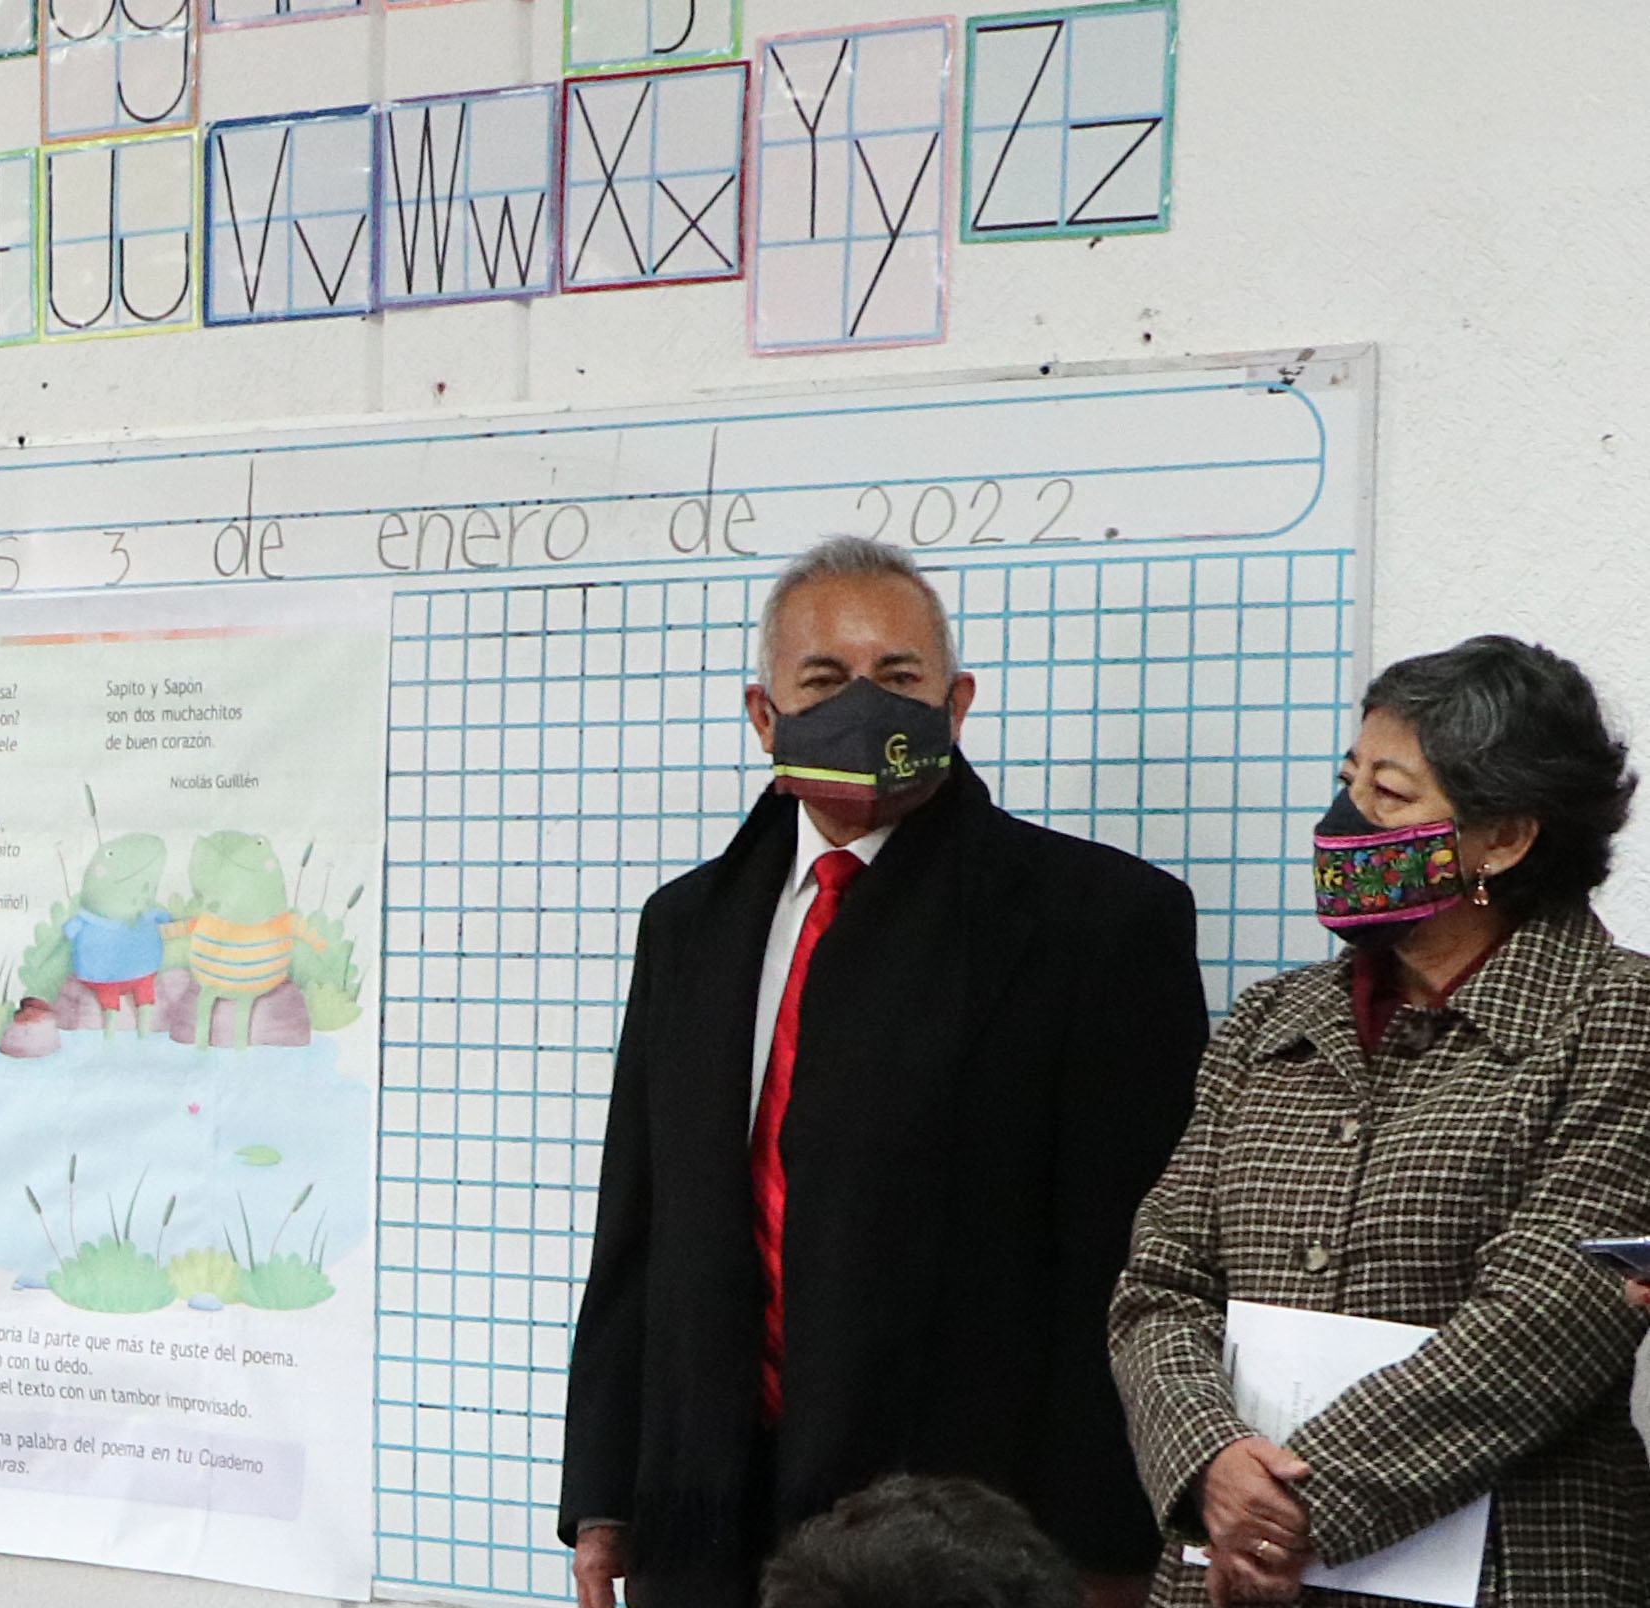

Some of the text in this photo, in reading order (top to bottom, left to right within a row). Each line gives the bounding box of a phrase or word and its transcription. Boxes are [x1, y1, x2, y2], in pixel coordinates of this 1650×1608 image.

[971, 20, 1163, 231] Zz
[388, 102, 545, 295] Ww
[570, 81, 736, 281] Xx
[770, 38, 939, 337] Yy
[217, 127, 366, 313] Vv
[103, 530, 131, 586] 3
[213, 458, 284, 580] de
[377, 503, 590, 572] enero
[668, 426, 758, 556] de
[106, 679, 146, 701] Sapito
[151, 682, 158, 700] y
[106, 703, 242, 725] son dos muchachitos
[105, 733, 122, 751] de
[125, 733, 158, 751] buen
[28, 1326, 40, 1345] la
[44, 1331, 80, 1350] parte
[85, 1335, 111, 1354] que
[150, 1338, 165, 1356] te
[170, 1342, 209, 1361] guste
[214, 1343, 236, 1363] del
[7, 1354, 30, 1371] con
[35, 1355, 50, 1373] tu
[17, 1380, 55, 1399] texto
[59, 1384, 85, 1400] con
[89, 1387, 107, 1403] un
[111, 1386, 161, 1408] tambor
[17, 1431, 67, 1453] palabra
[73, 1436, 95, 1455] del
[101, 1441, 145, 1460] poema
[151, 1446, 170, 1462] en
[177, 1447, 193, 1465] tu
